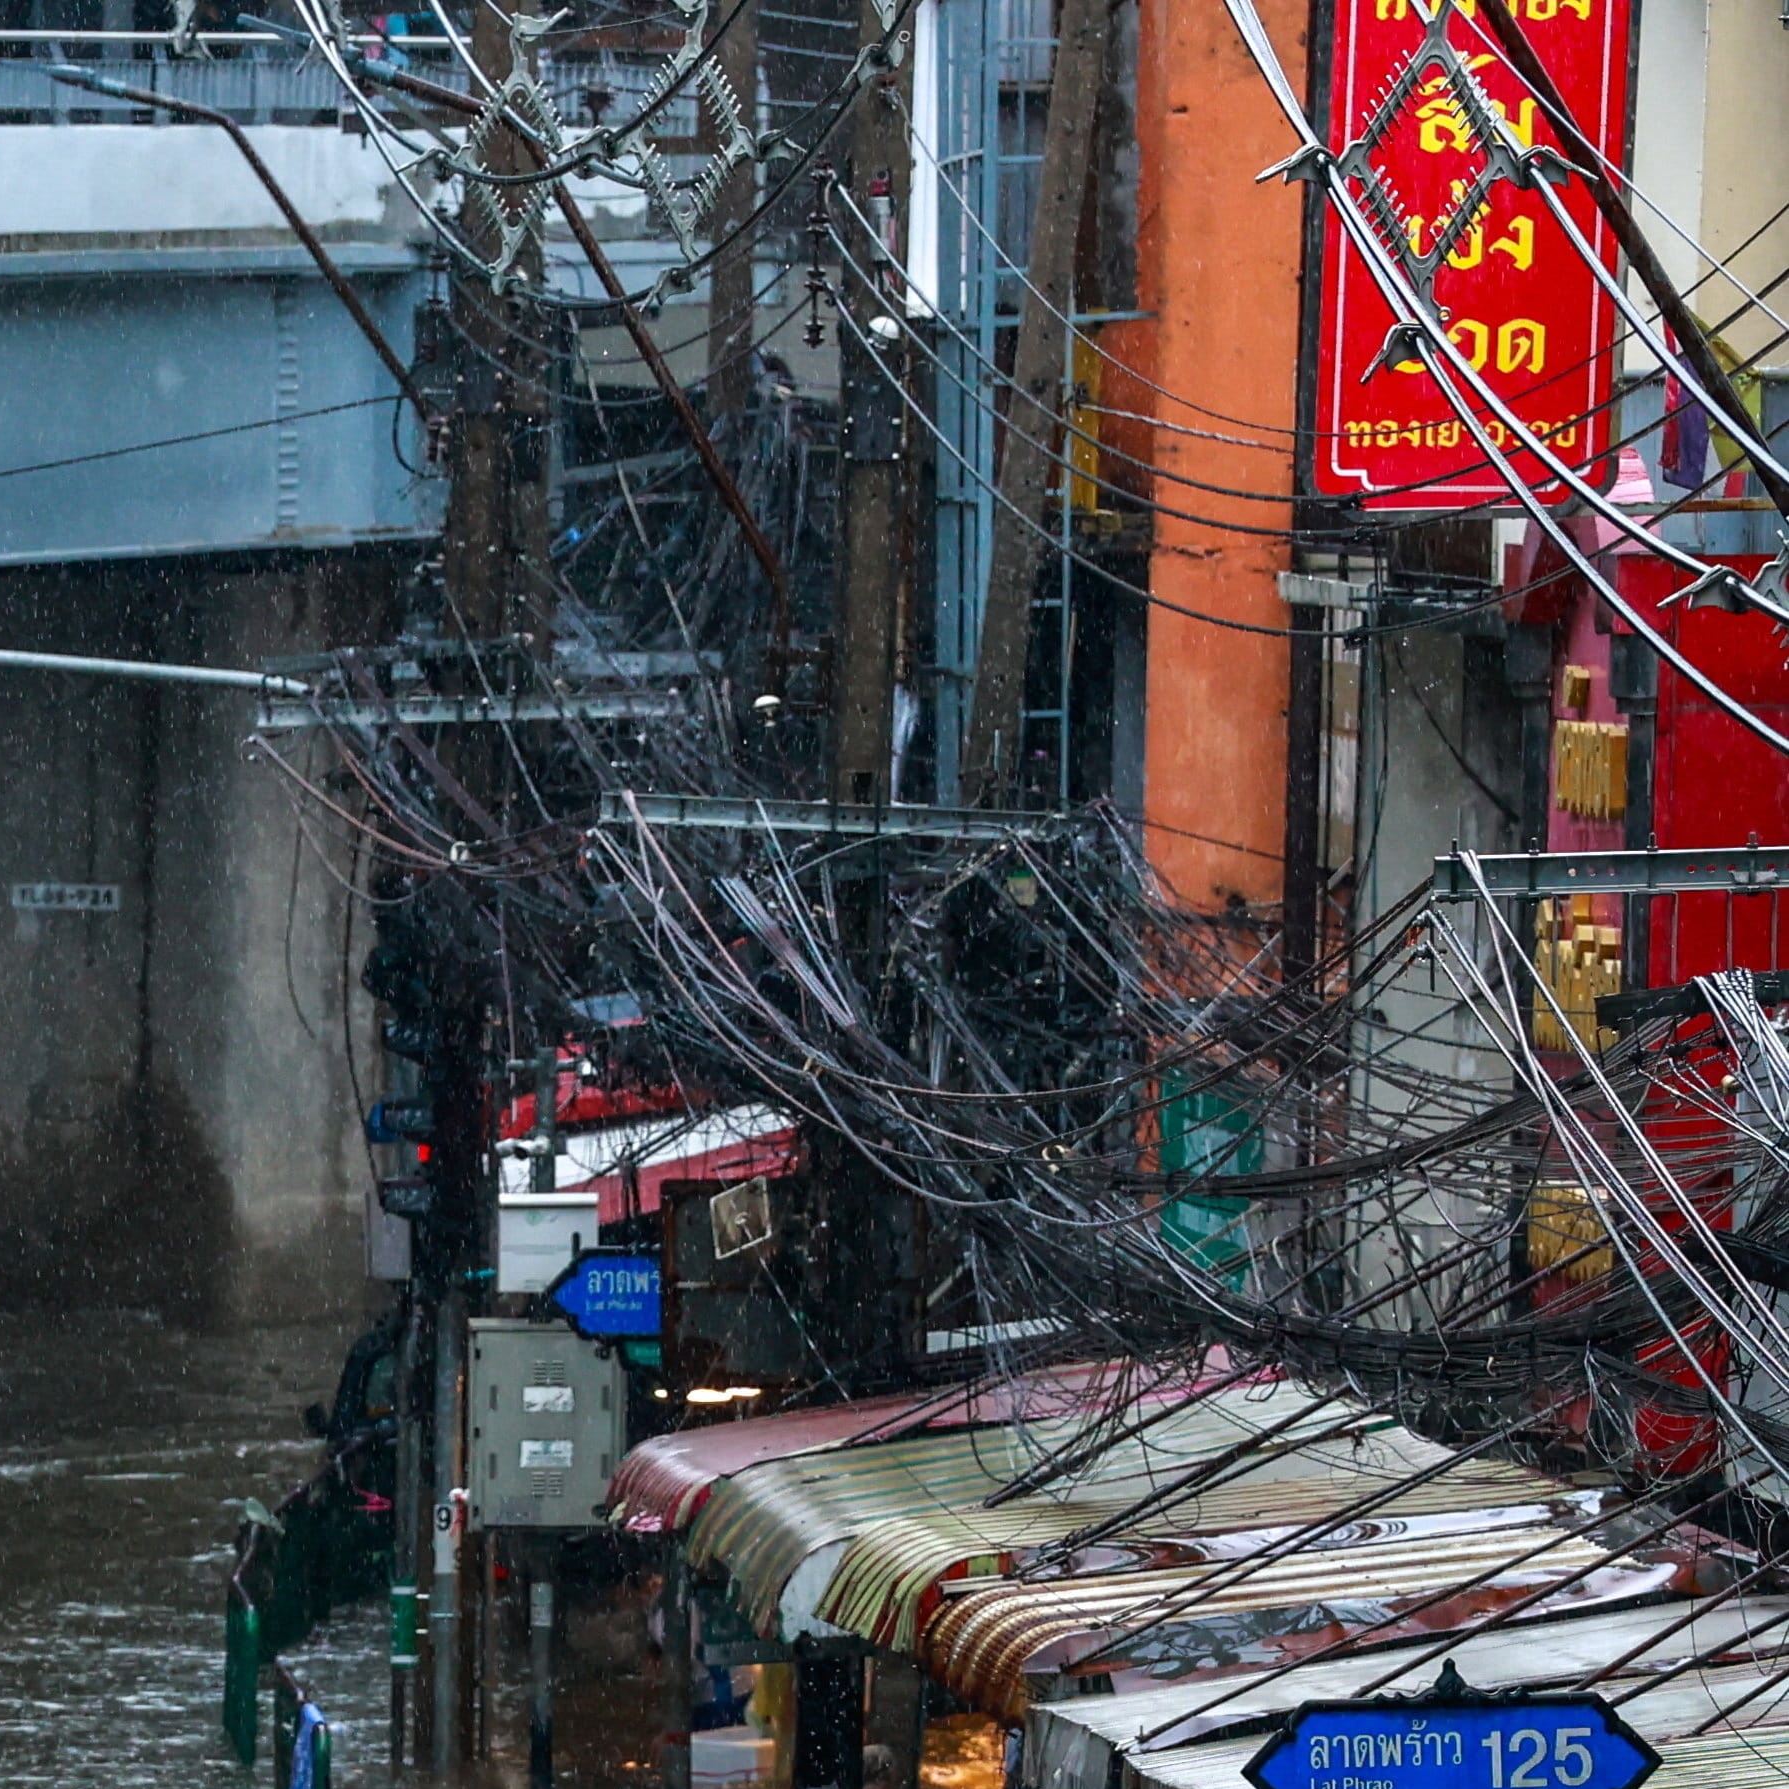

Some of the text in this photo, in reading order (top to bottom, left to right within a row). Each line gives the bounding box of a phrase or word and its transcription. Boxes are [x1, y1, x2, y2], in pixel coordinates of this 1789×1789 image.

[1393, 318, 1545, 376] วด
[437, 1506, 451, 1531] 9
[1308, 1719, 1593, 1789] ลาดพร้าว 125
